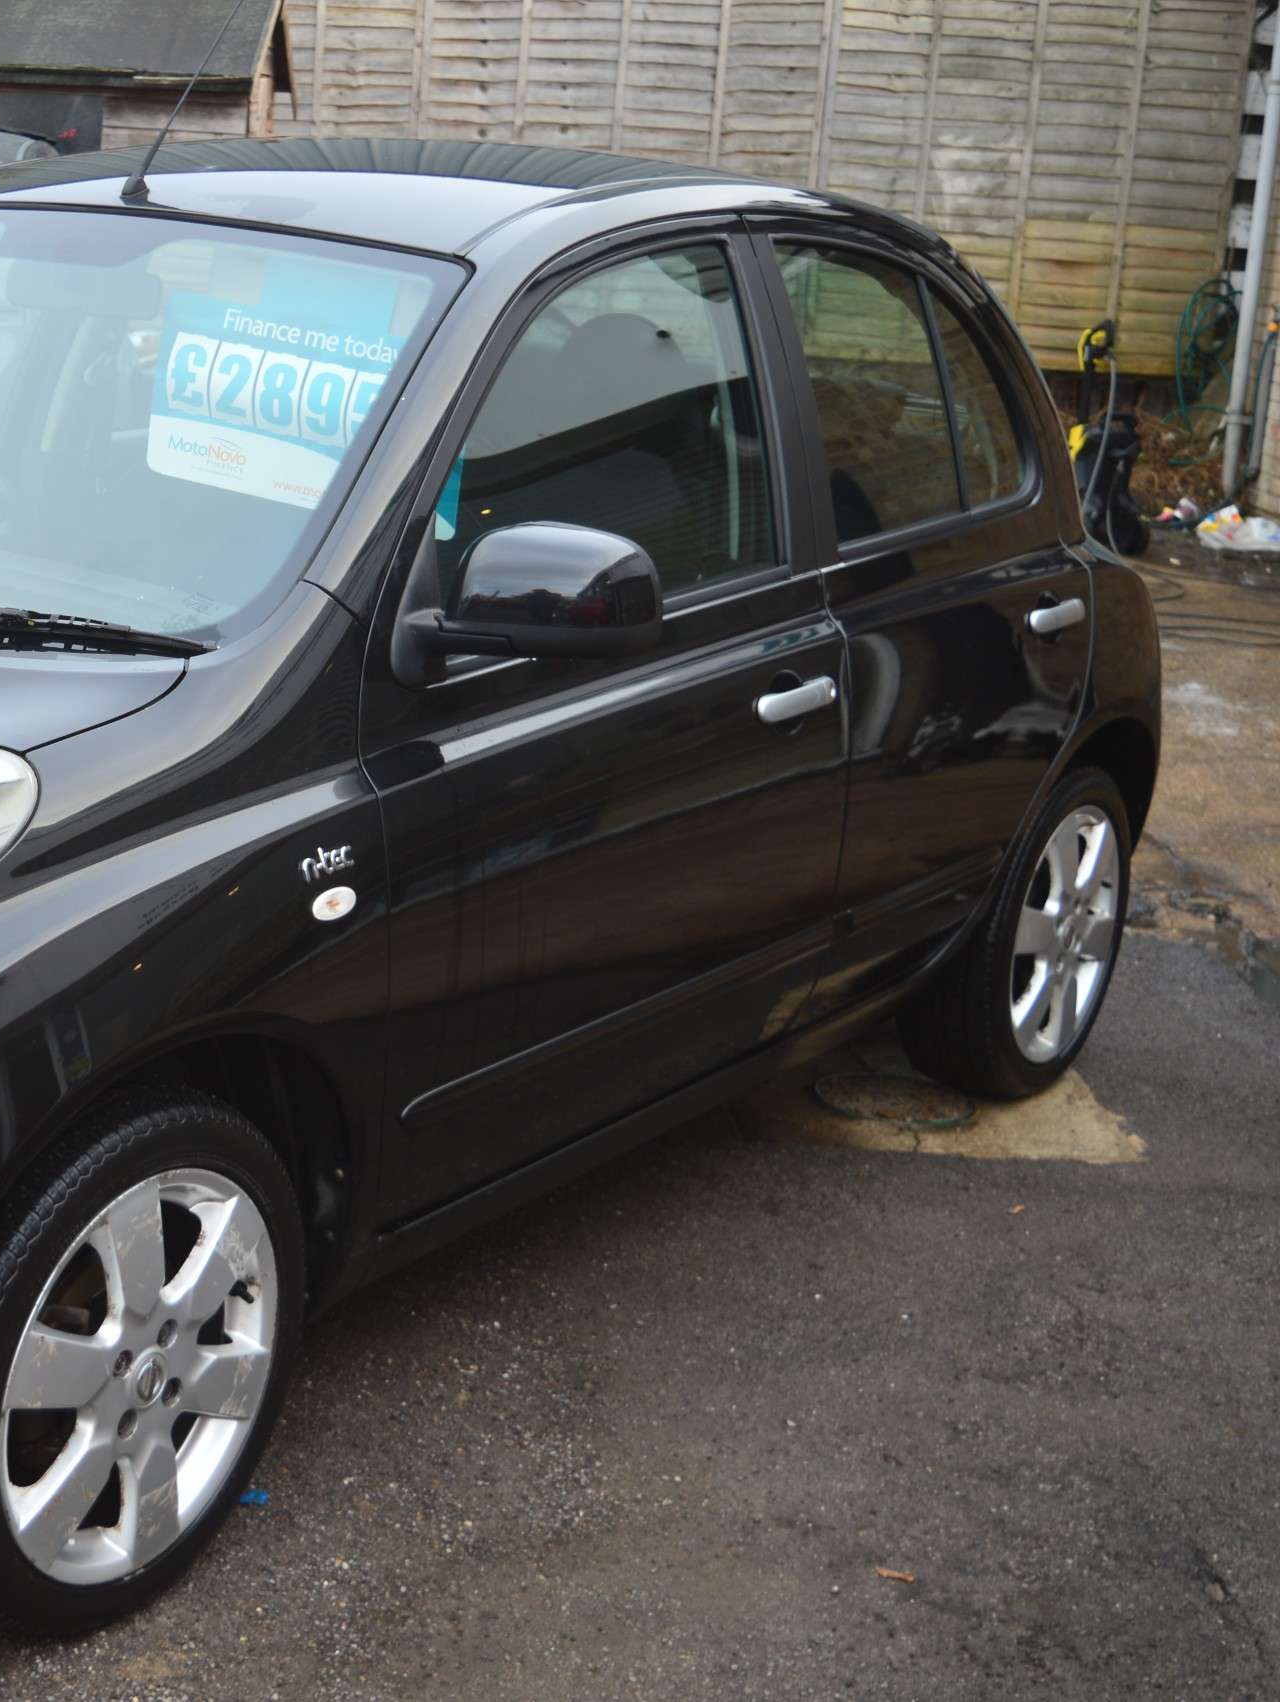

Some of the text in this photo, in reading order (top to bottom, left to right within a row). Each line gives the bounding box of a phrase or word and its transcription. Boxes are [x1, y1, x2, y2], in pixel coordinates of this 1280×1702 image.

[222, 308, 302, 345] Finance
[304, 328, 340, 353] me
[167, 434, 247, 466] MotoNovo
